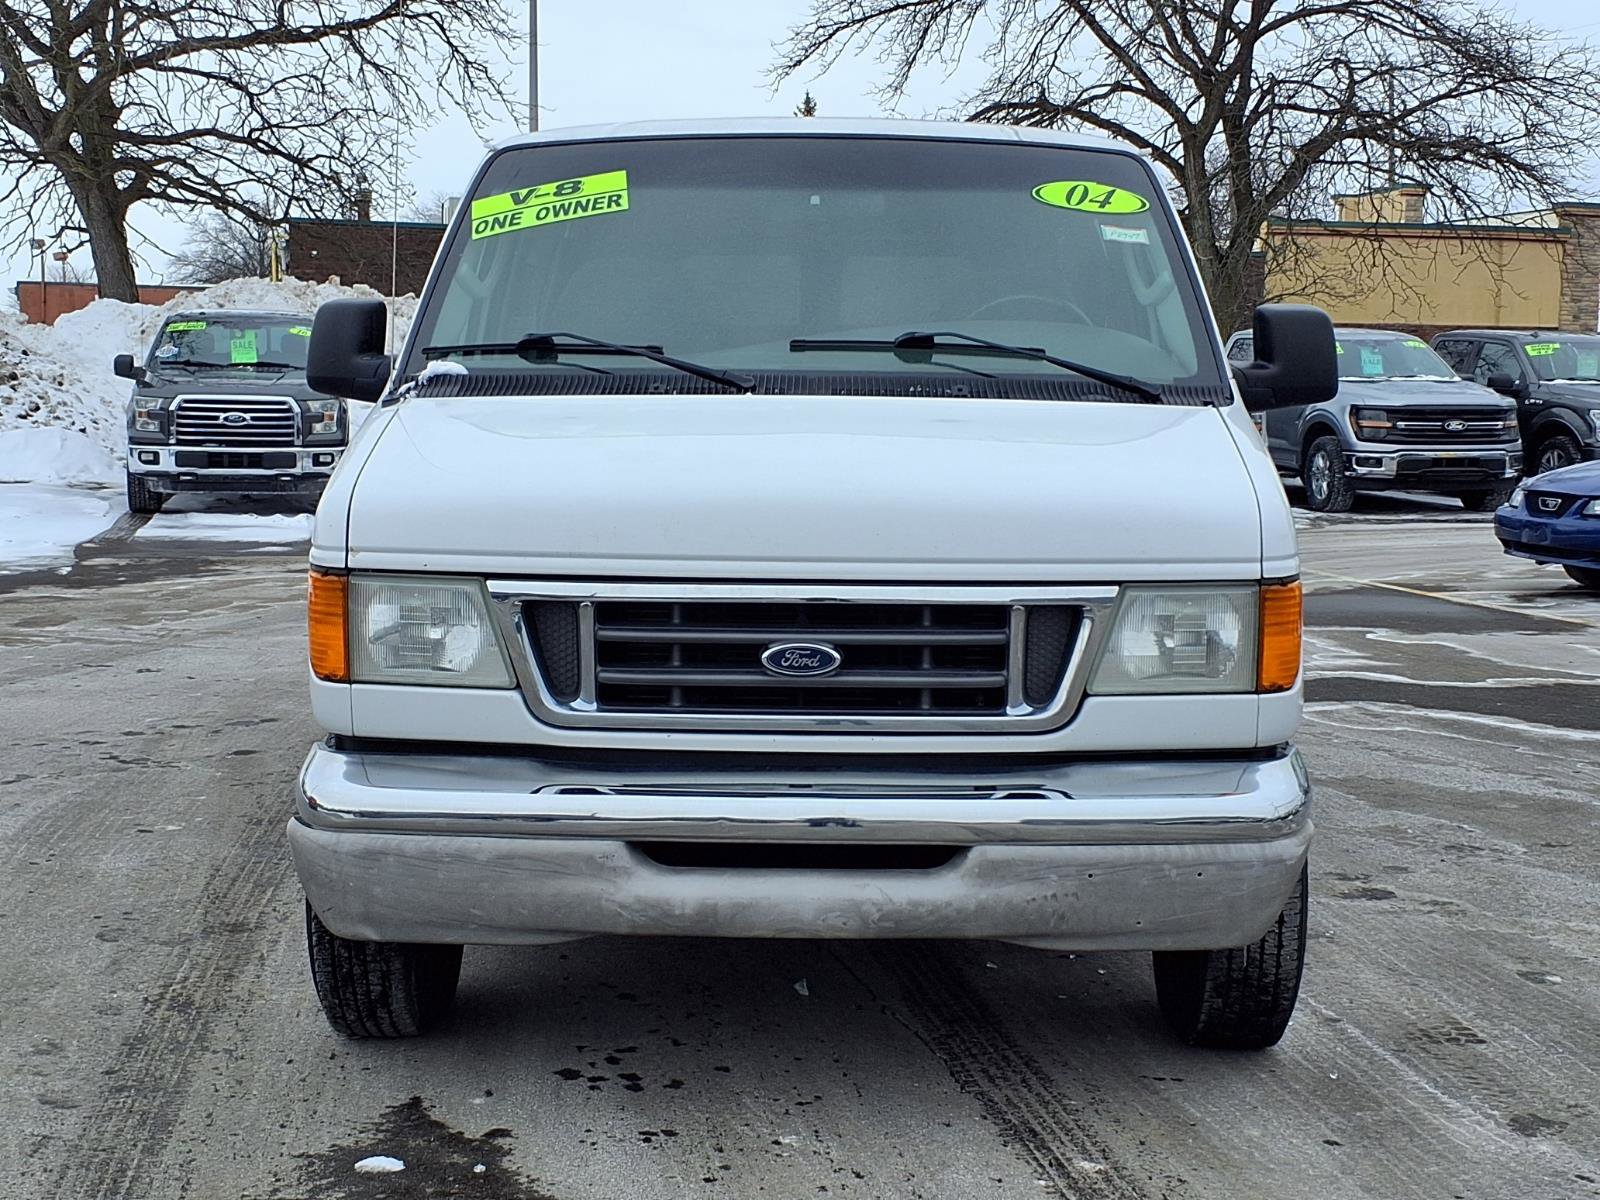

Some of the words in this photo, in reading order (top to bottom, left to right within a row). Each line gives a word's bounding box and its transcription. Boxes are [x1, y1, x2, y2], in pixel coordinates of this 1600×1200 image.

[509, 180, 584, 206] V-8
[1065, 184, 1117, 209] 04
[474, 211, 523, 234] ONE
[535, 193, 622, 221] OWNER
[781, 649, 820, 667] Ford
